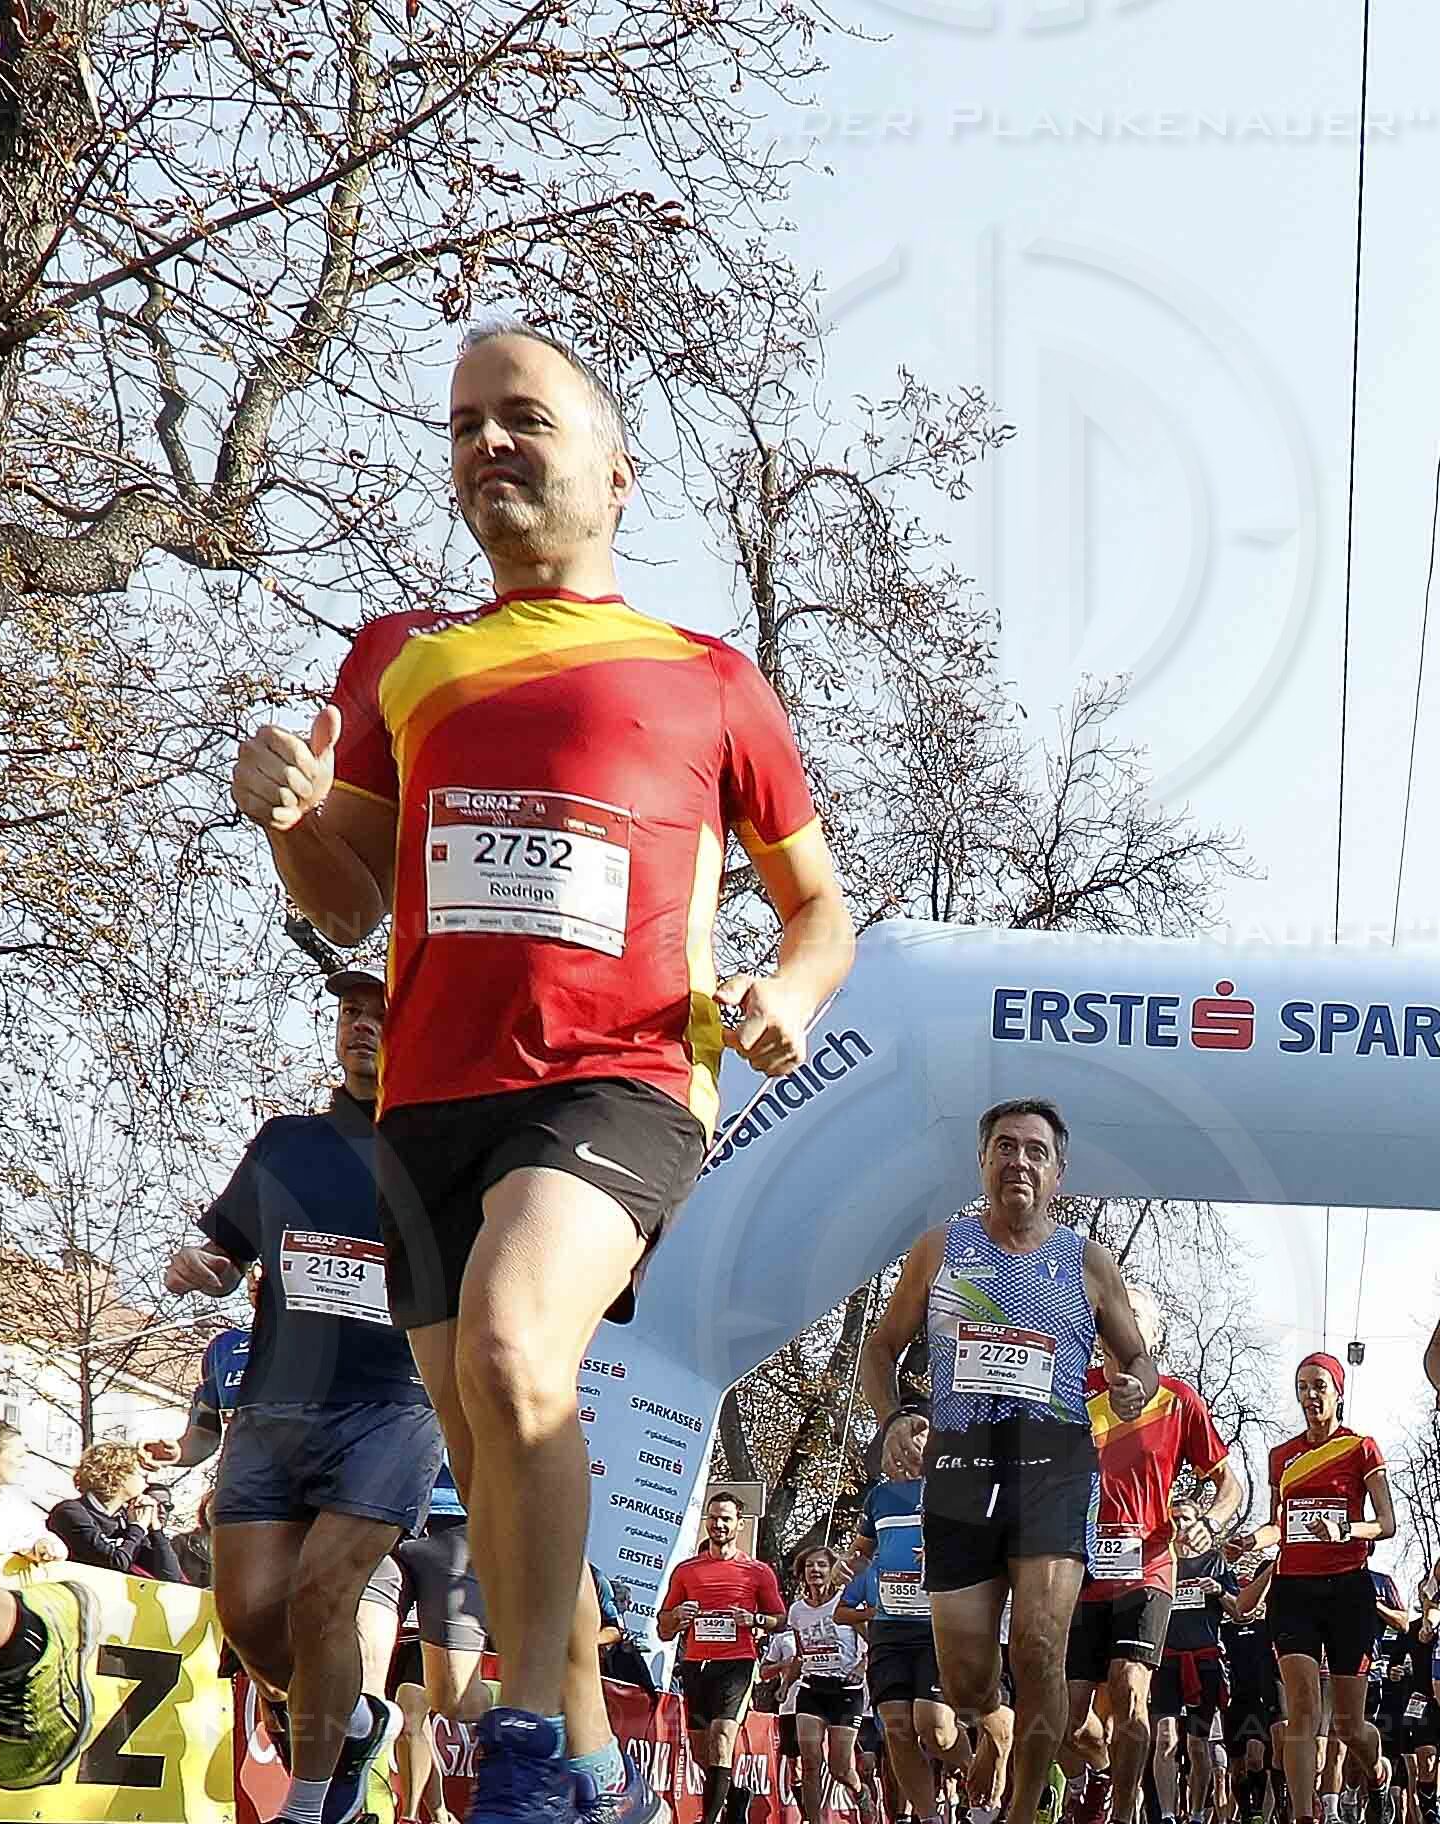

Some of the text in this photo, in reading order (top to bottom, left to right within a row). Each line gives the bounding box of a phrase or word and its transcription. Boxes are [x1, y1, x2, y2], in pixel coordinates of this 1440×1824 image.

[471, 795, 521, 811] GRAZ
[474, 832, 573, 871] 2752
[489, 881, 555, 903] Rodrigo
[993, 988, 1180, 1048] ERSTE
[306, 1256, 366, 1282] 2134
[315, 1285, 352, 1297] Werner
[979, 1345, 1029, 1365] 2729
[987, 1368, 1017, 1379] Alfredo
[630, 1397, 695, 1430] SPARKASSE
[639, 1450, 673, 1472] ERSTE
[610, 1493, 675, 1524] SPARKASSE
[618, 1547, 654, 1568] ERSTE
[1095, 1540, 1122, 1554] 782
[889, 1584, 917, 1596] 5856
